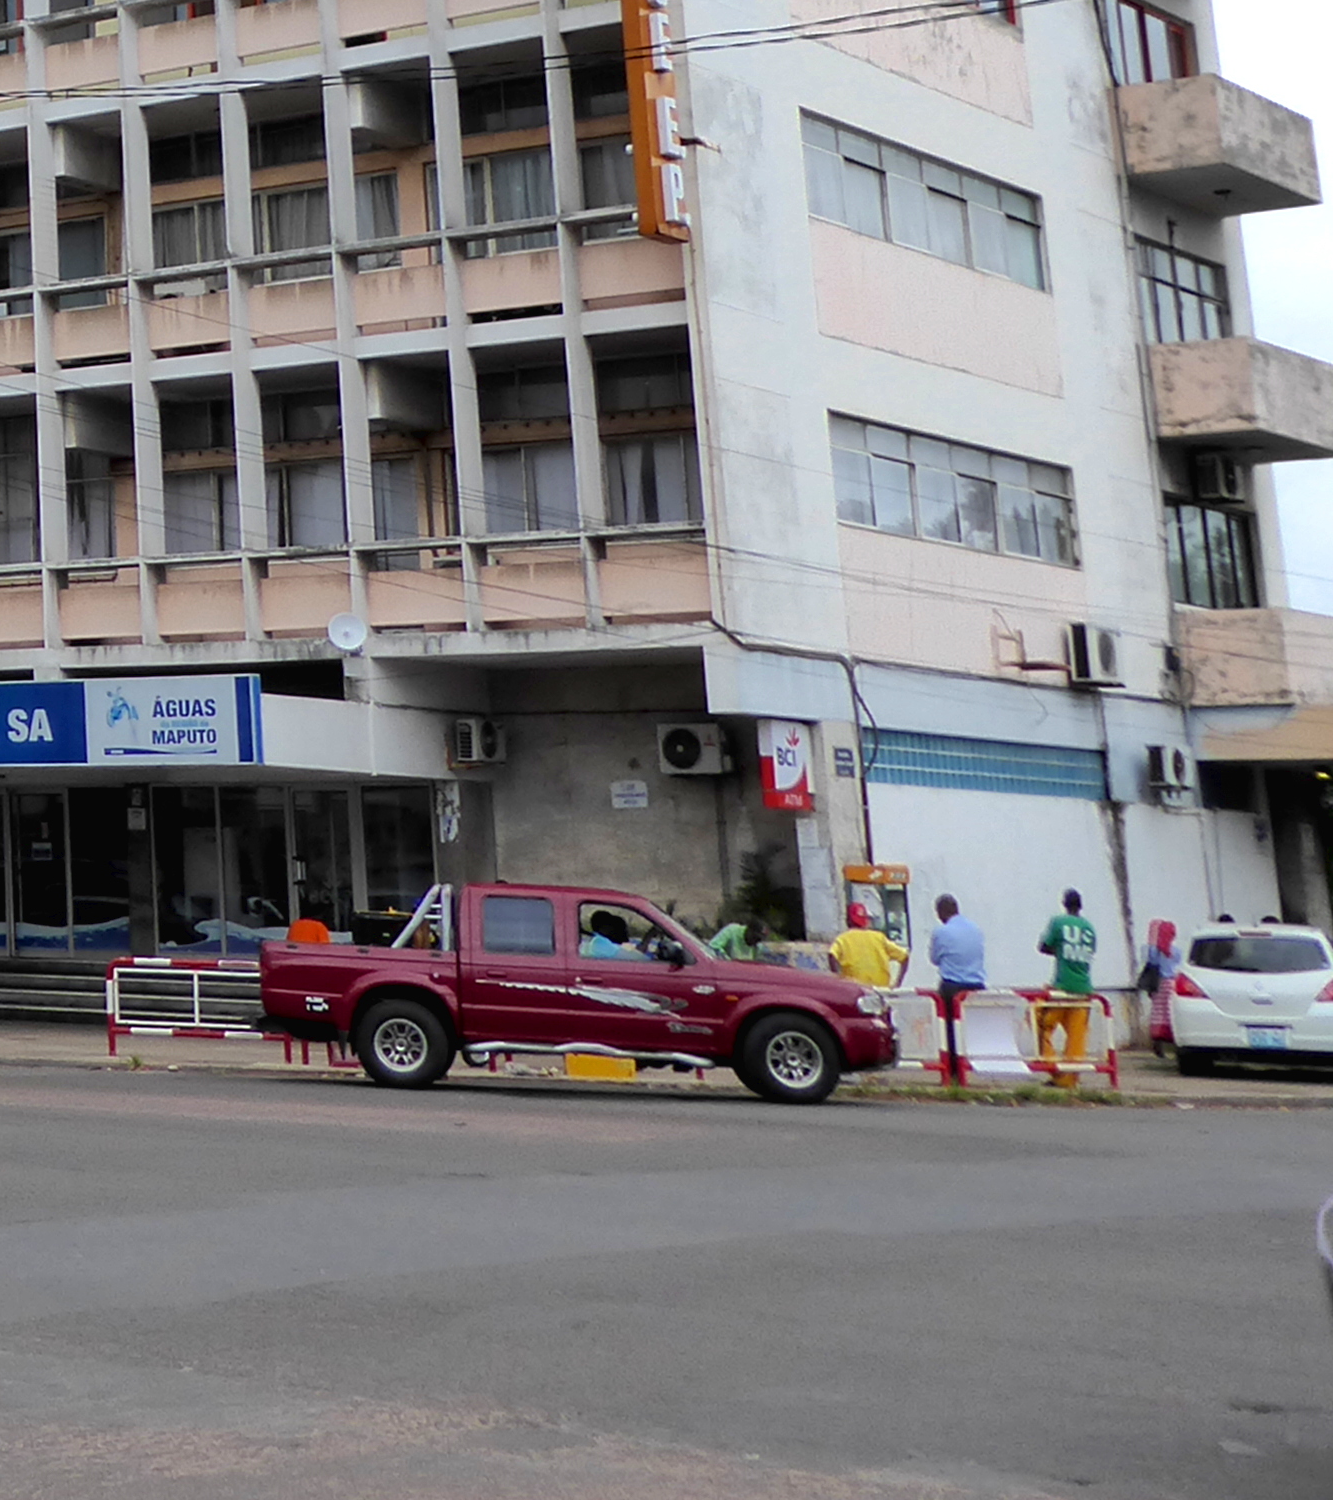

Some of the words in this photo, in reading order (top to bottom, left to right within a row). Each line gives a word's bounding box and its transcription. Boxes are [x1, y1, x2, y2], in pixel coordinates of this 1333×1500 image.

[152, 695, 217, 718] ÁGUAS
[7, 708, 54, 743] SA
[151, 728, 217, 745] MAPUTO
[776, 746, 797, 768] BCI
